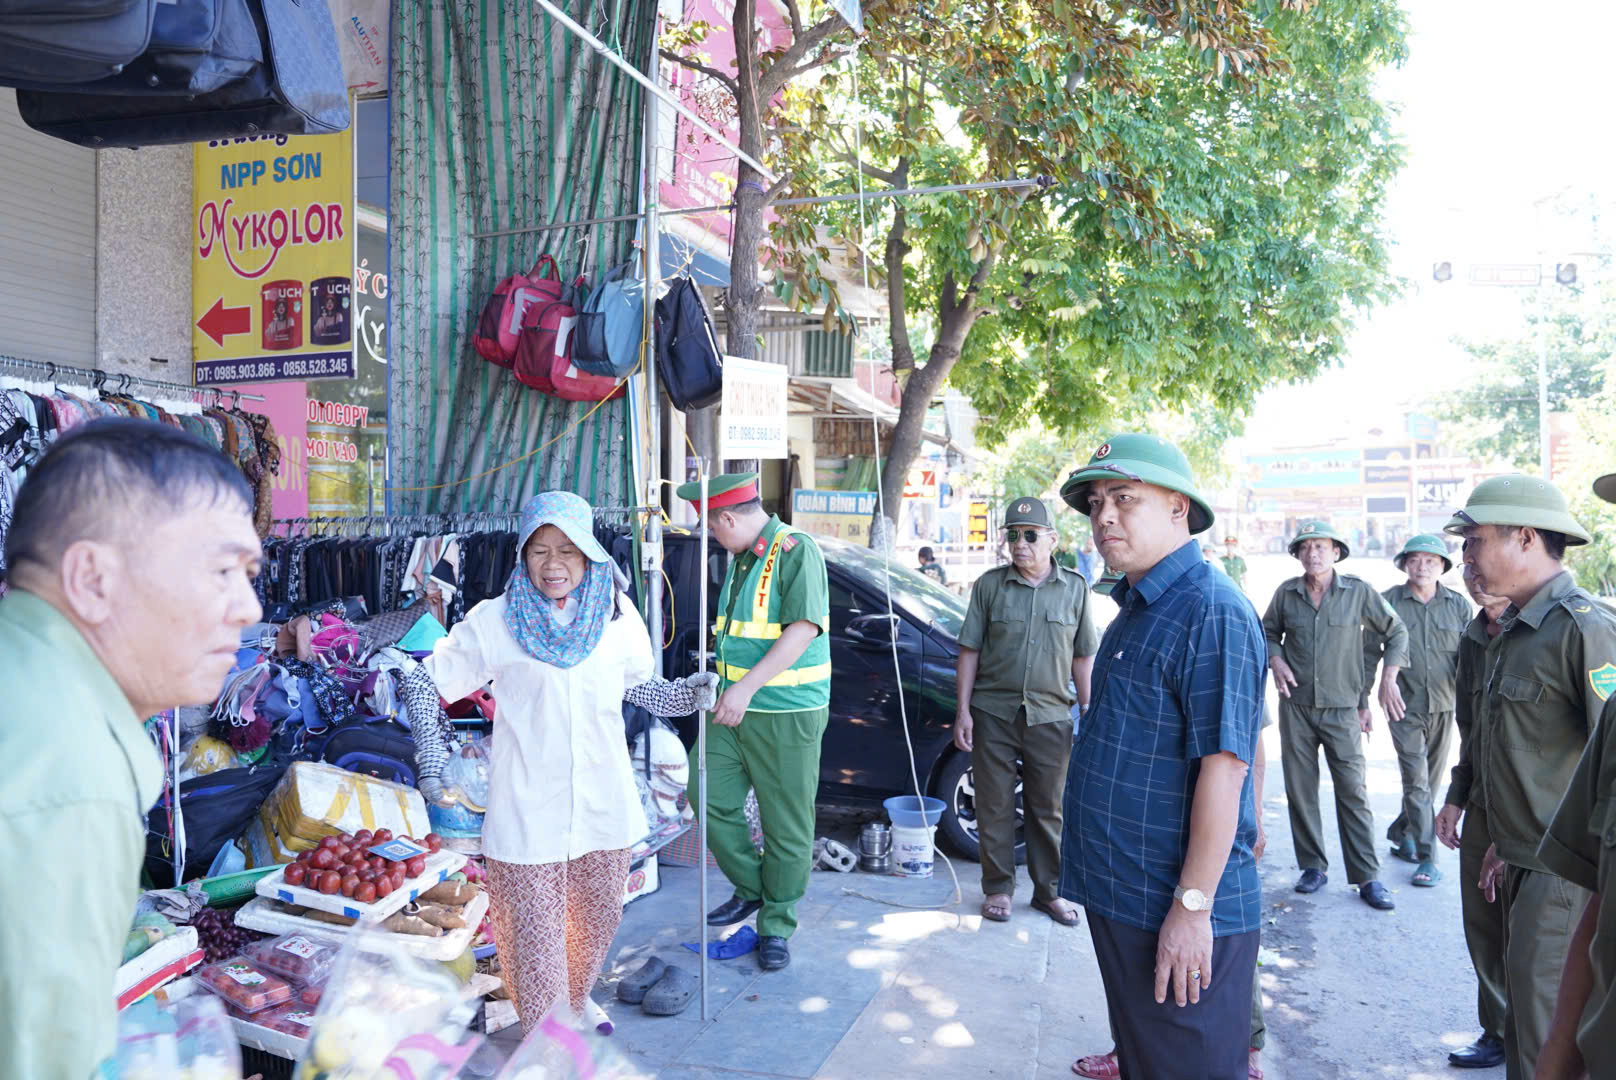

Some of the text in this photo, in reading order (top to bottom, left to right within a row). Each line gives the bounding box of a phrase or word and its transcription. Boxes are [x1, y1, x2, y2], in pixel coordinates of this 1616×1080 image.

[221, 152, 322, 189] NPP SƠN
[214, 363, 275, 380] 0985.903.866
[283, 358, 347, 375] 0858.528.345
[307, 399, 368, 428] OTOCOPY
[757, 542, 779, 607] CSTT
